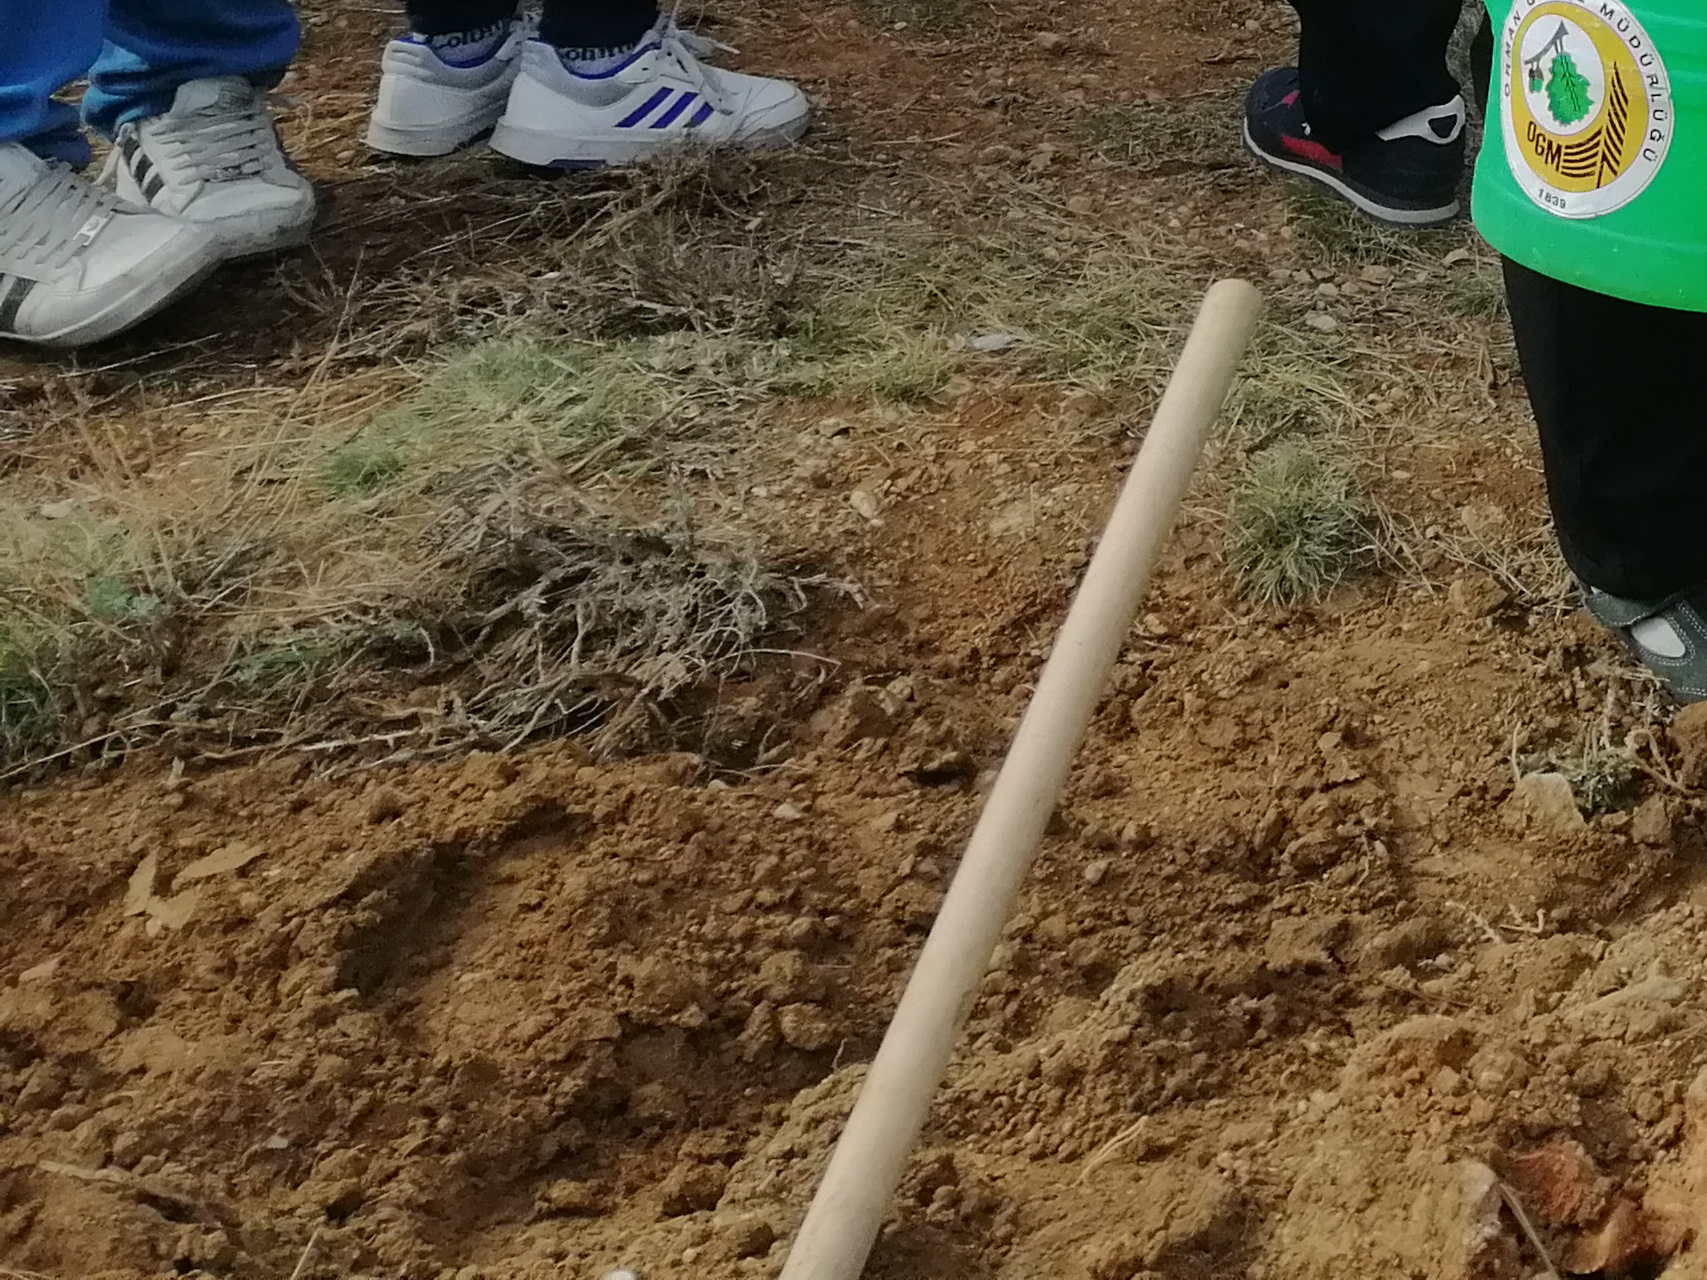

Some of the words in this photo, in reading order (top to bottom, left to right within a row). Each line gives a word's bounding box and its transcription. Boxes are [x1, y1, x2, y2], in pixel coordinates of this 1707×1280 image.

[1504, 10, 1521, 97] ORMAN
[1600, 2, 1668, 162] MÜDÜRLÜĞÜ
[1527, 121, 1562, 172] OGM
[1538, 188, 1567, 209] 1839
